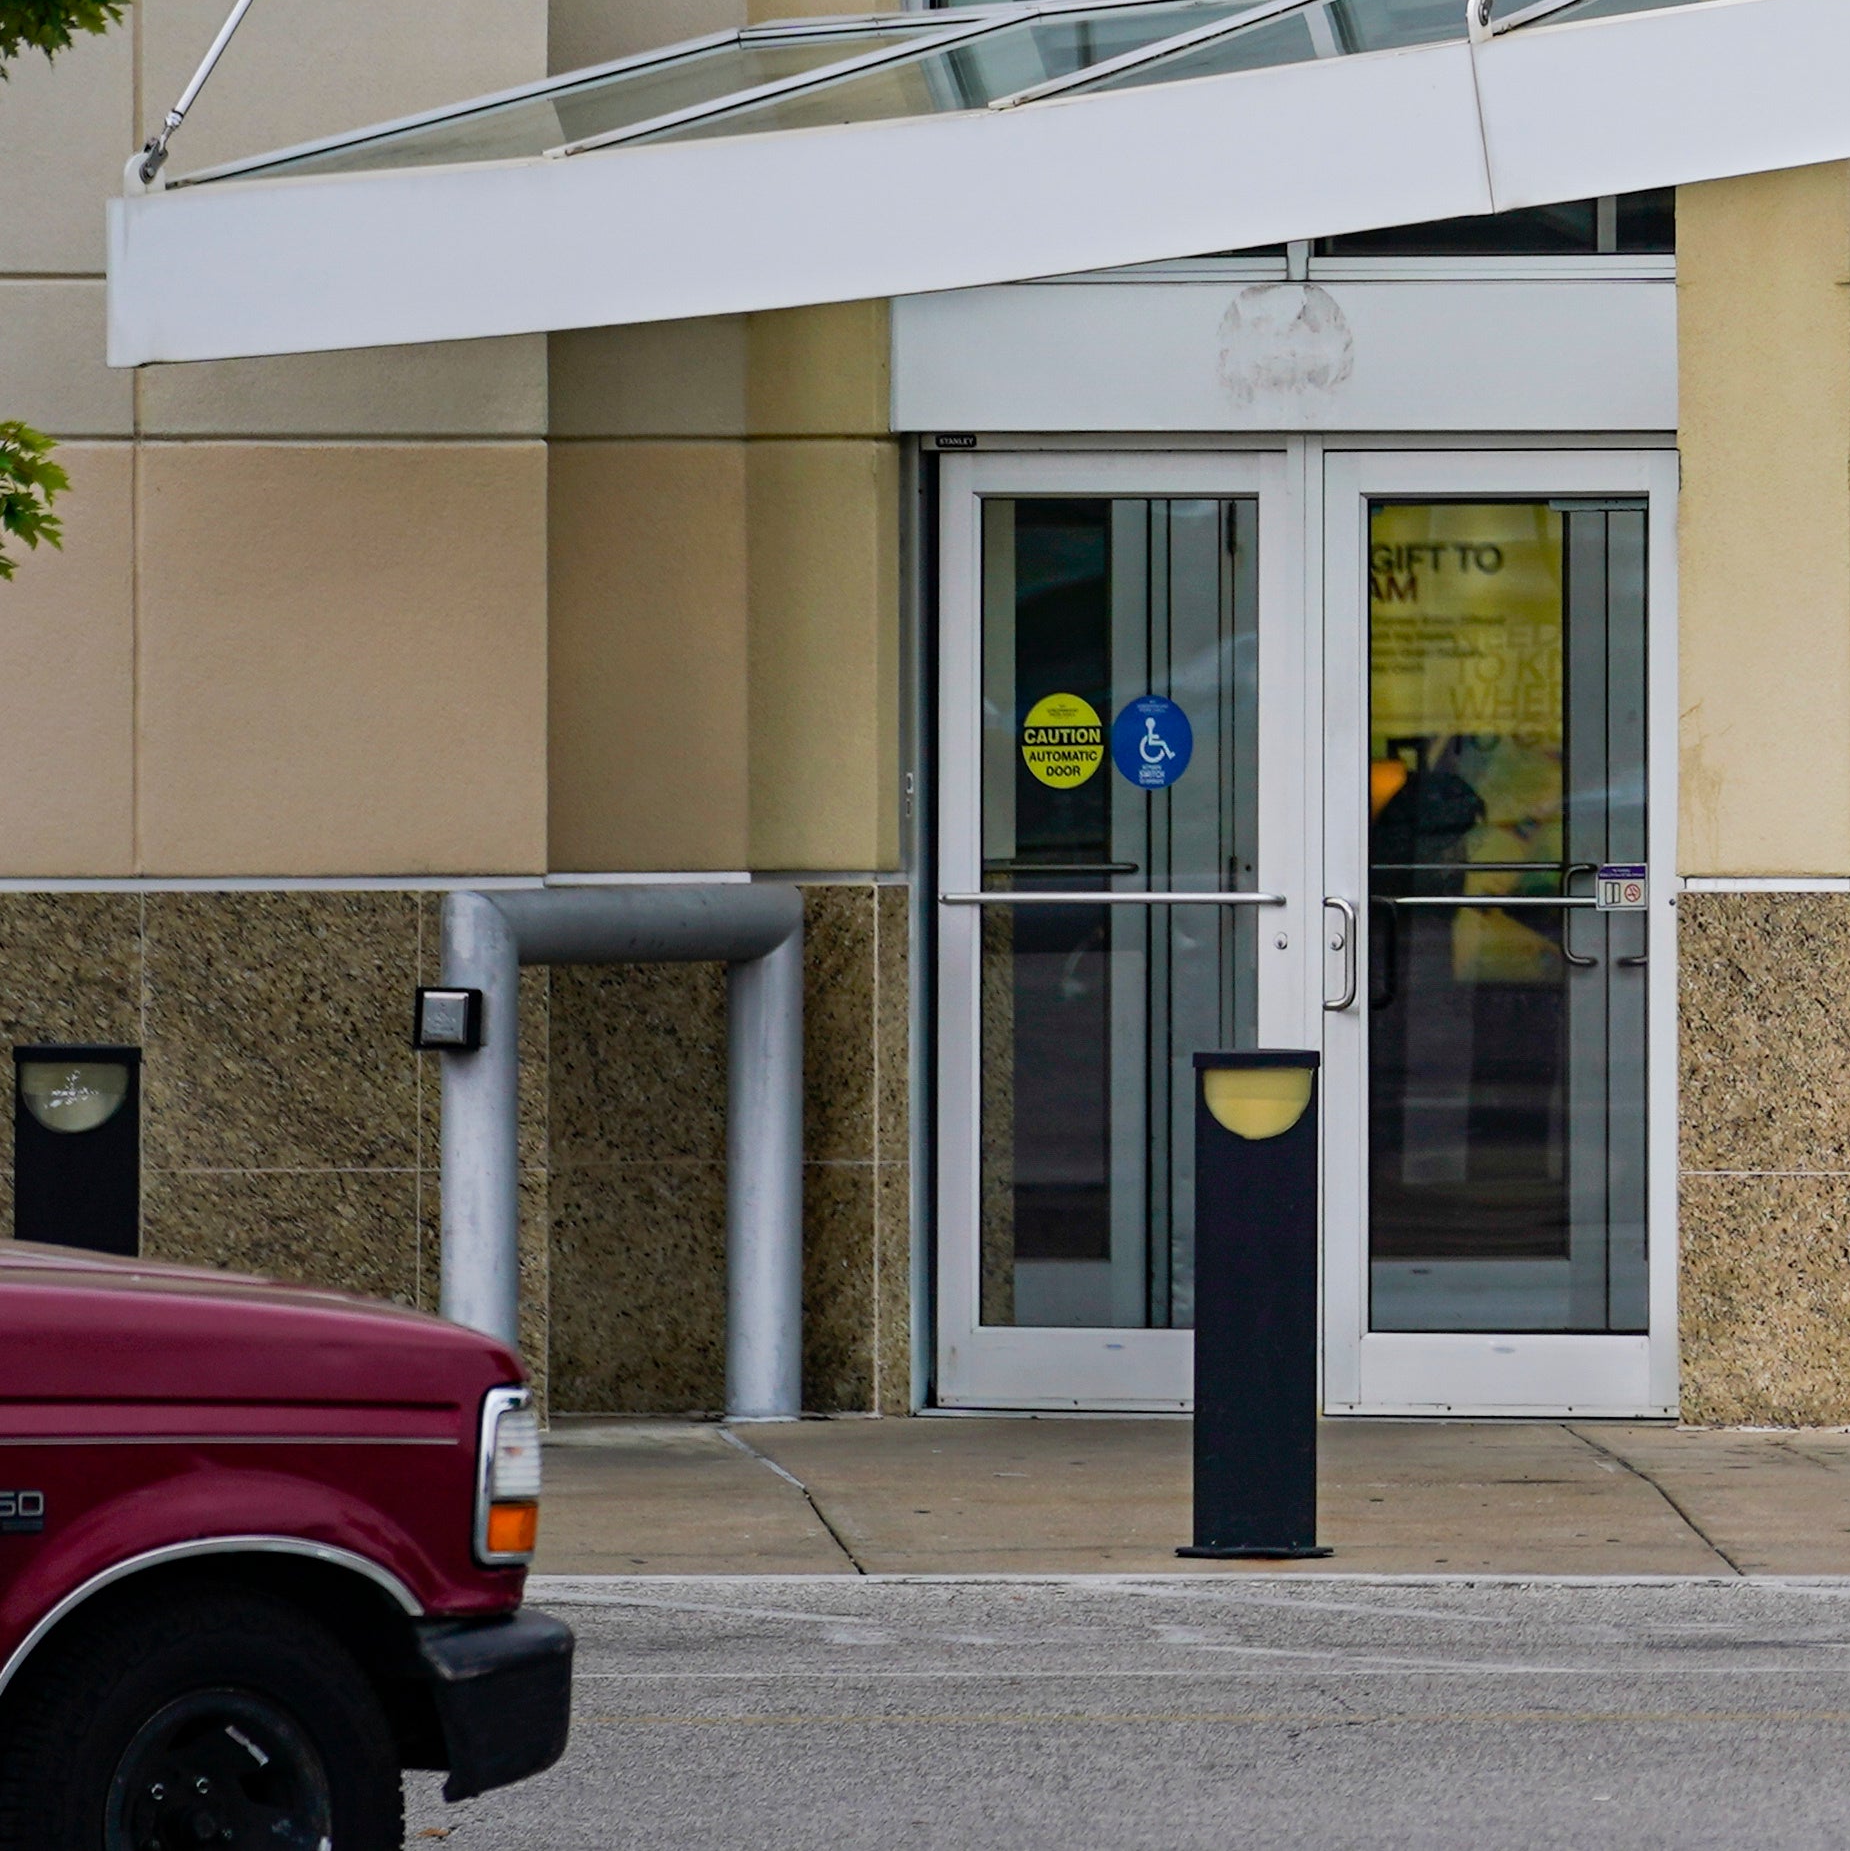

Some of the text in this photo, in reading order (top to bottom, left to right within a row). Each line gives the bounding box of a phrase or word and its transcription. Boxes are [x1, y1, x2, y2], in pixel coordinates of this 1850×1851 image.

[1371, 542, 1504, 575] GIFT TO
[1024, 728, 1100, 744] CAUTION
[1029, 751, 1098, 762] AUTOMATIC
[1046, 766, 1080, 776] DOOR
